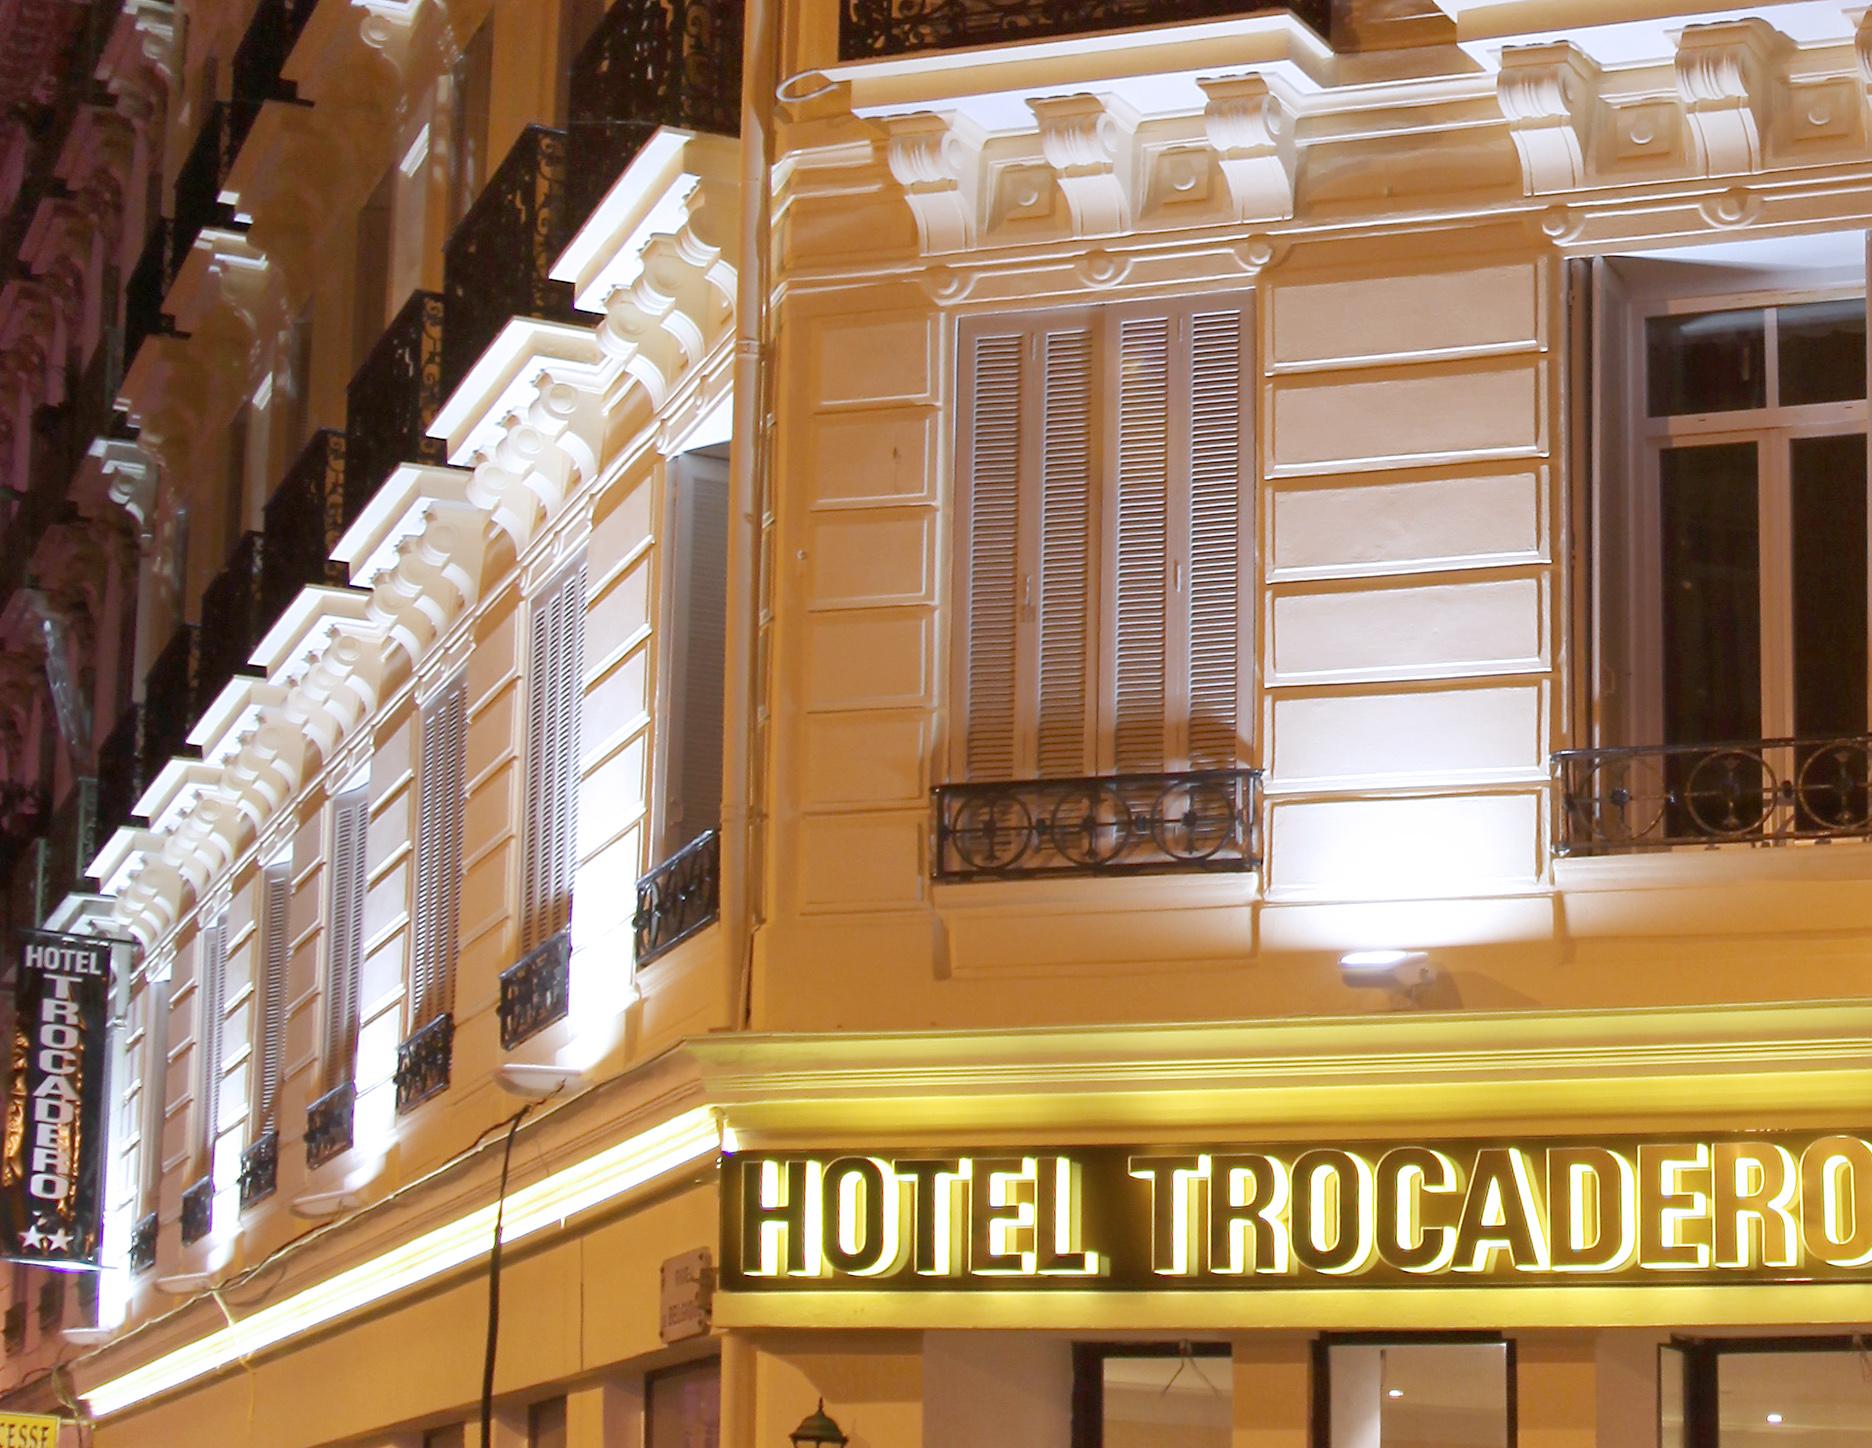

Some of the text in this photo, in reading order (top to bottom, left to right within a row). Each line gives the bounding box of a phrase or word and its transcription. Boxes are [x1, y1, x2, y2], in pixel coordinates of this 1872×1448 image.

[25, 944, 102, 975] HOTEL
[30, 973, 83, 1199] TROCADERO
[741, 1155, 1100, 1276] HOTEL
